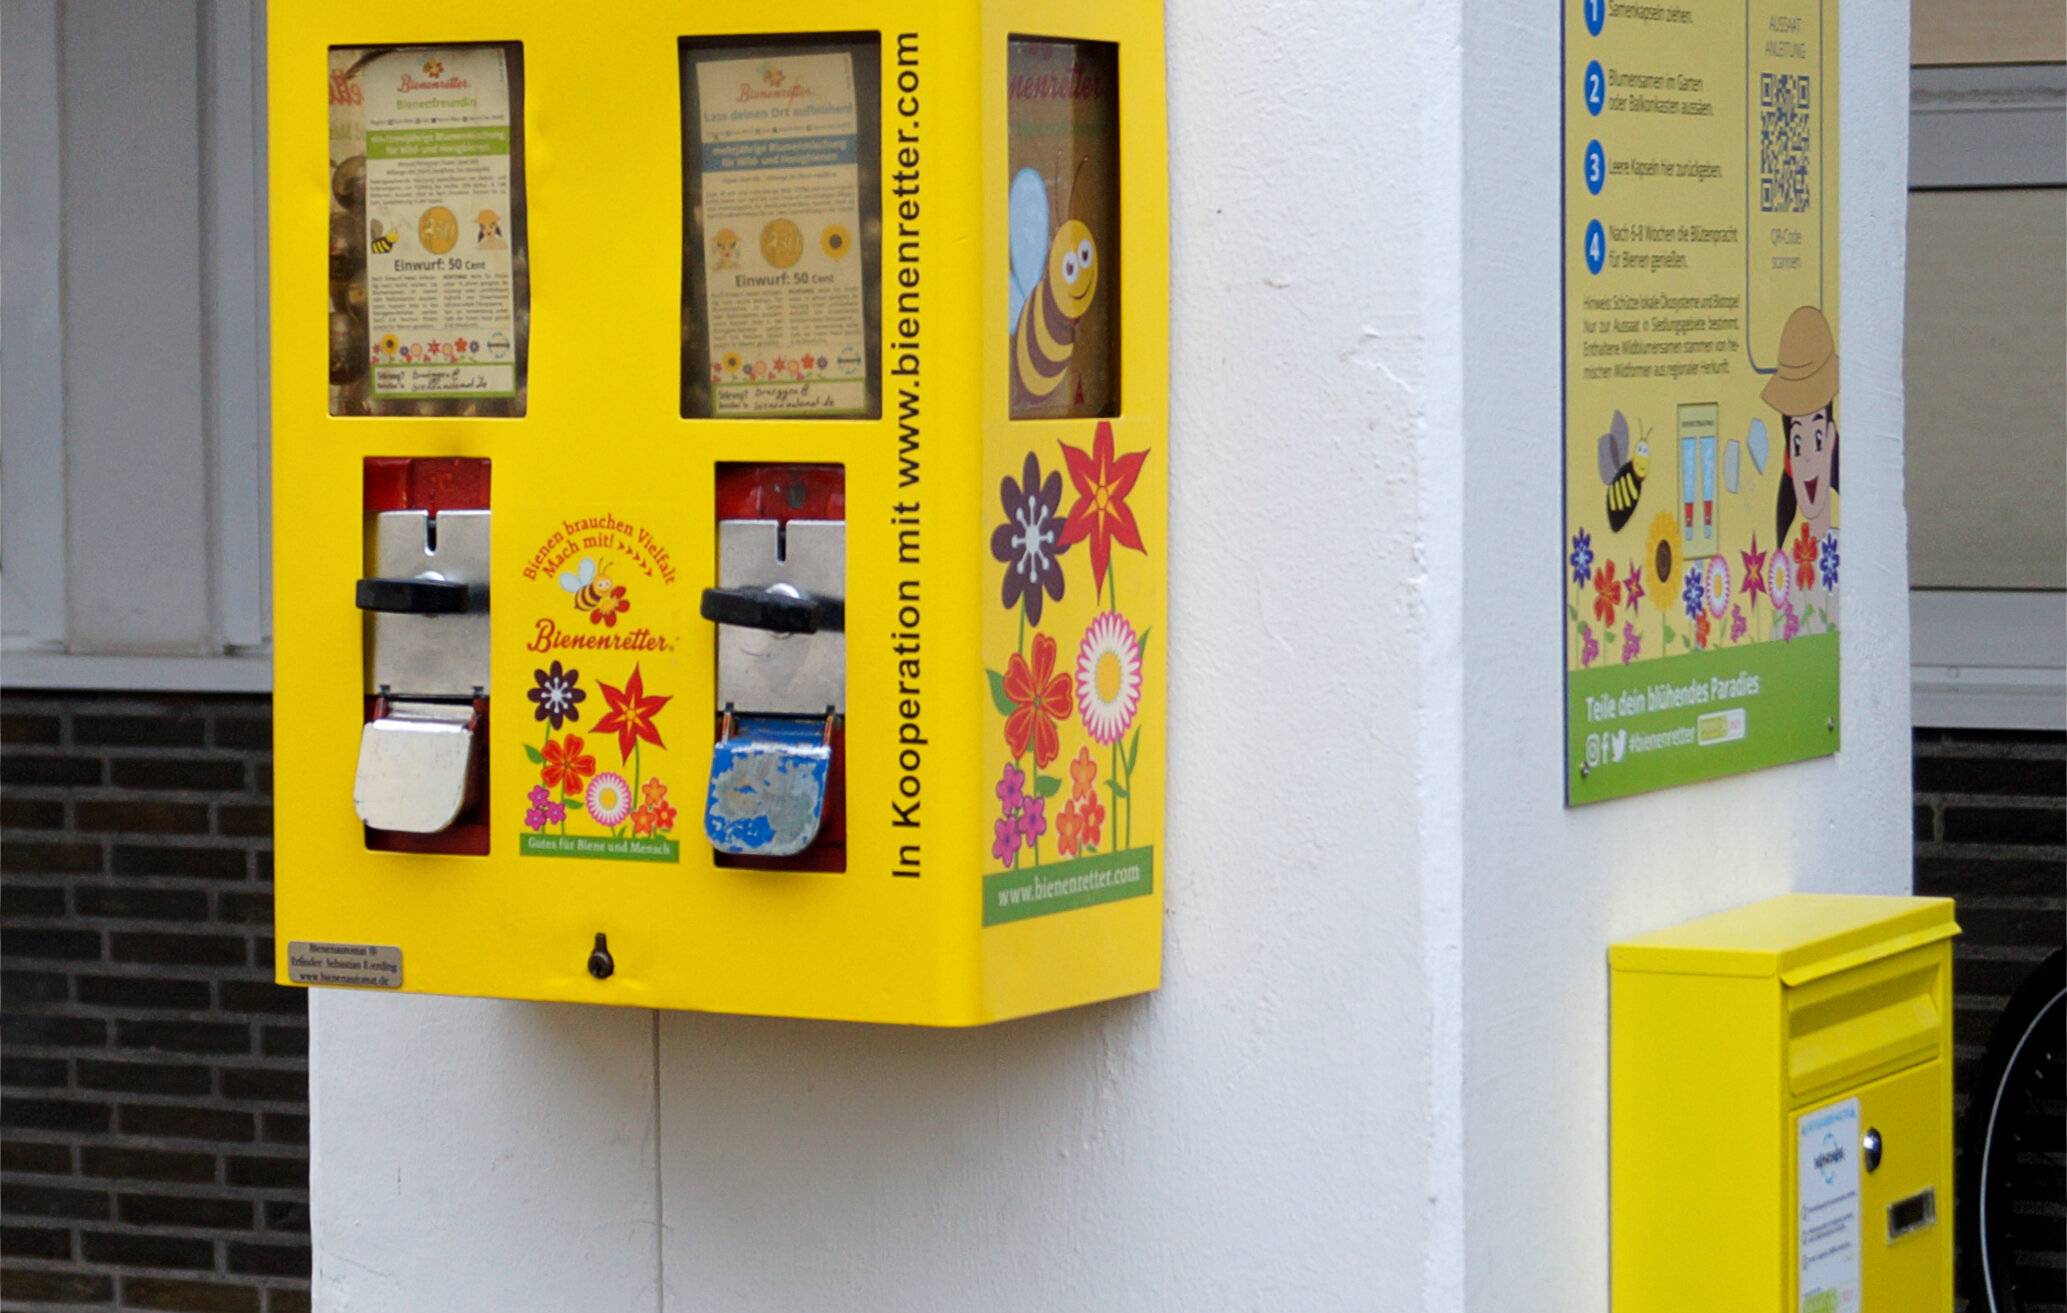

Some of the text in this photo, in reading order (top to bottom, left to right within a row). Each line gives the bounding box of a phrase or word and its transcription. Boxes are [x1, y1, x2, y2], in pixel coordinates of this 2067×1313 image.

[1589, 74, 1599, 102] 2
[771, 107, 790, 118] Ort
[1590, 153, 1599, 181] 3
[1589, 232, 1599, 260] 4
[394, 258, 486, 272] Einwurf: 50 Cent
[735, 272, 834, 288] Einwurf: 50 Cent
[890, 32, 928, 878] In Kooperation mit www.bienenretter.com
[523, 513, 676, 585] Bienen brauchen Vielfalt
[542, 533, 615, 579] Mach mit!
[527, 617, 668, 653] Bienenretter
[1586, 671, 1759, 722] Teile dein blühendes Paradies
[528, 837, 671, 854] Gutes für Biene und Mensch
[998, 864, 1140, 907] www.bienenretter.com
